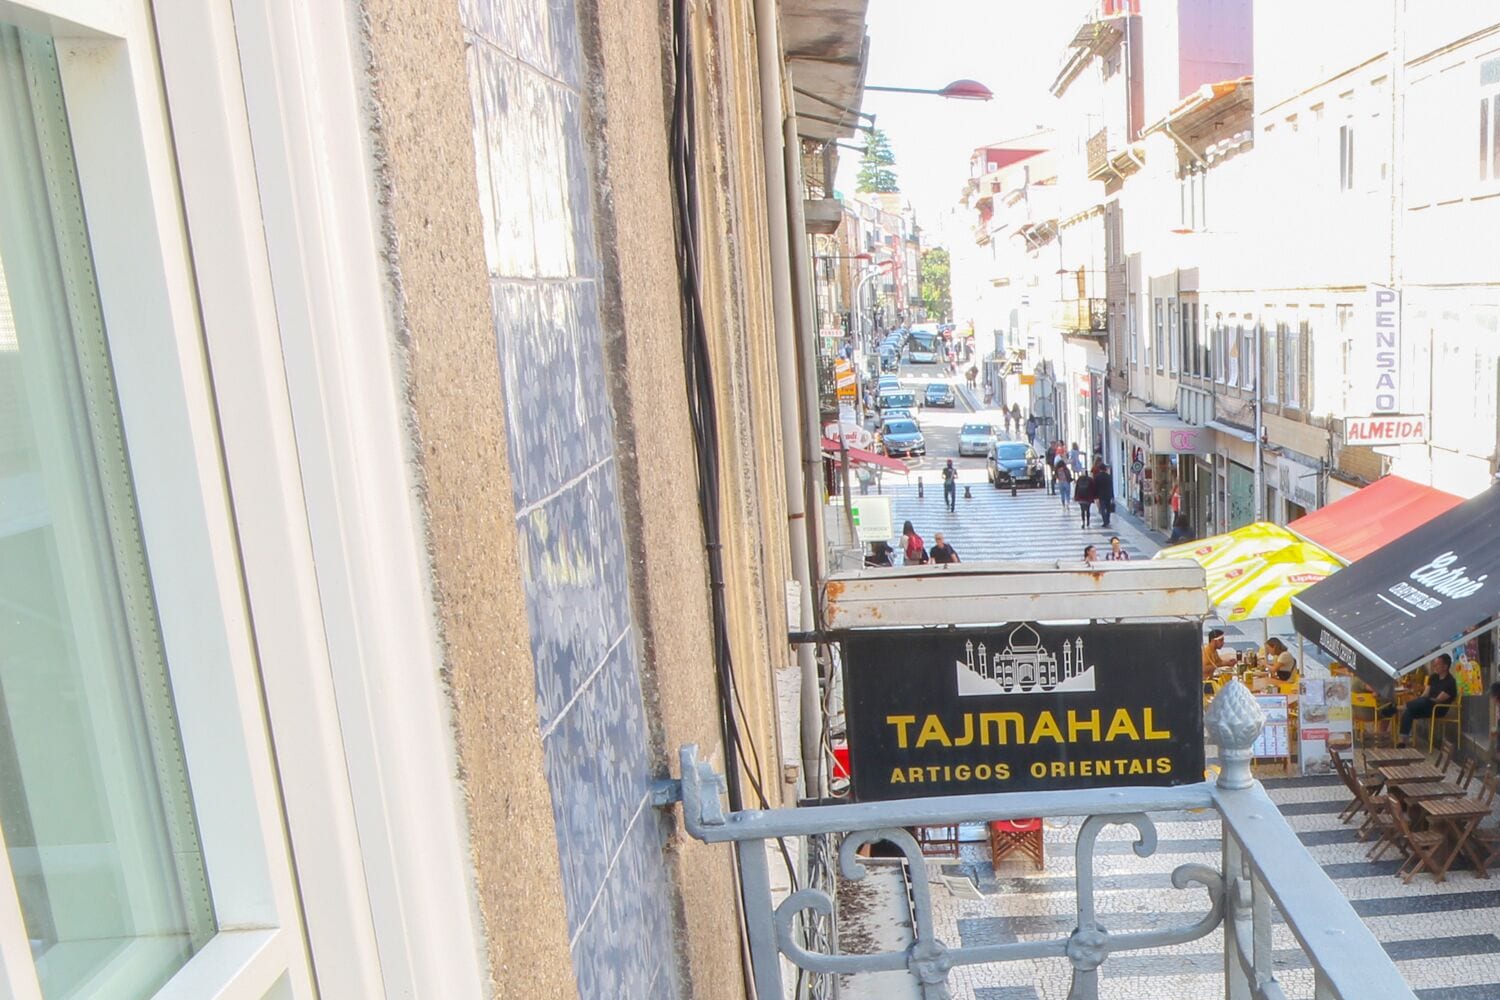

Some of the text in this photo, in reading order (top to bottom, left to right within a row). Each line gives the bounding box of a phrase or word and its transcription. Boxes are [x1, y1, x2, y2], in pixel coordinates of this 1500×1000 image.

[1376, 290, 1396, 410] PENSÃO
[1348, 421, 1424, 440] ALMEIDA
[1410, 551, 1488, 599] Catraio
[886, 707, 1170, 749] TAJMAHAL
[890, 757, 1172, 784] ARTIGOS ORIENTAIS
